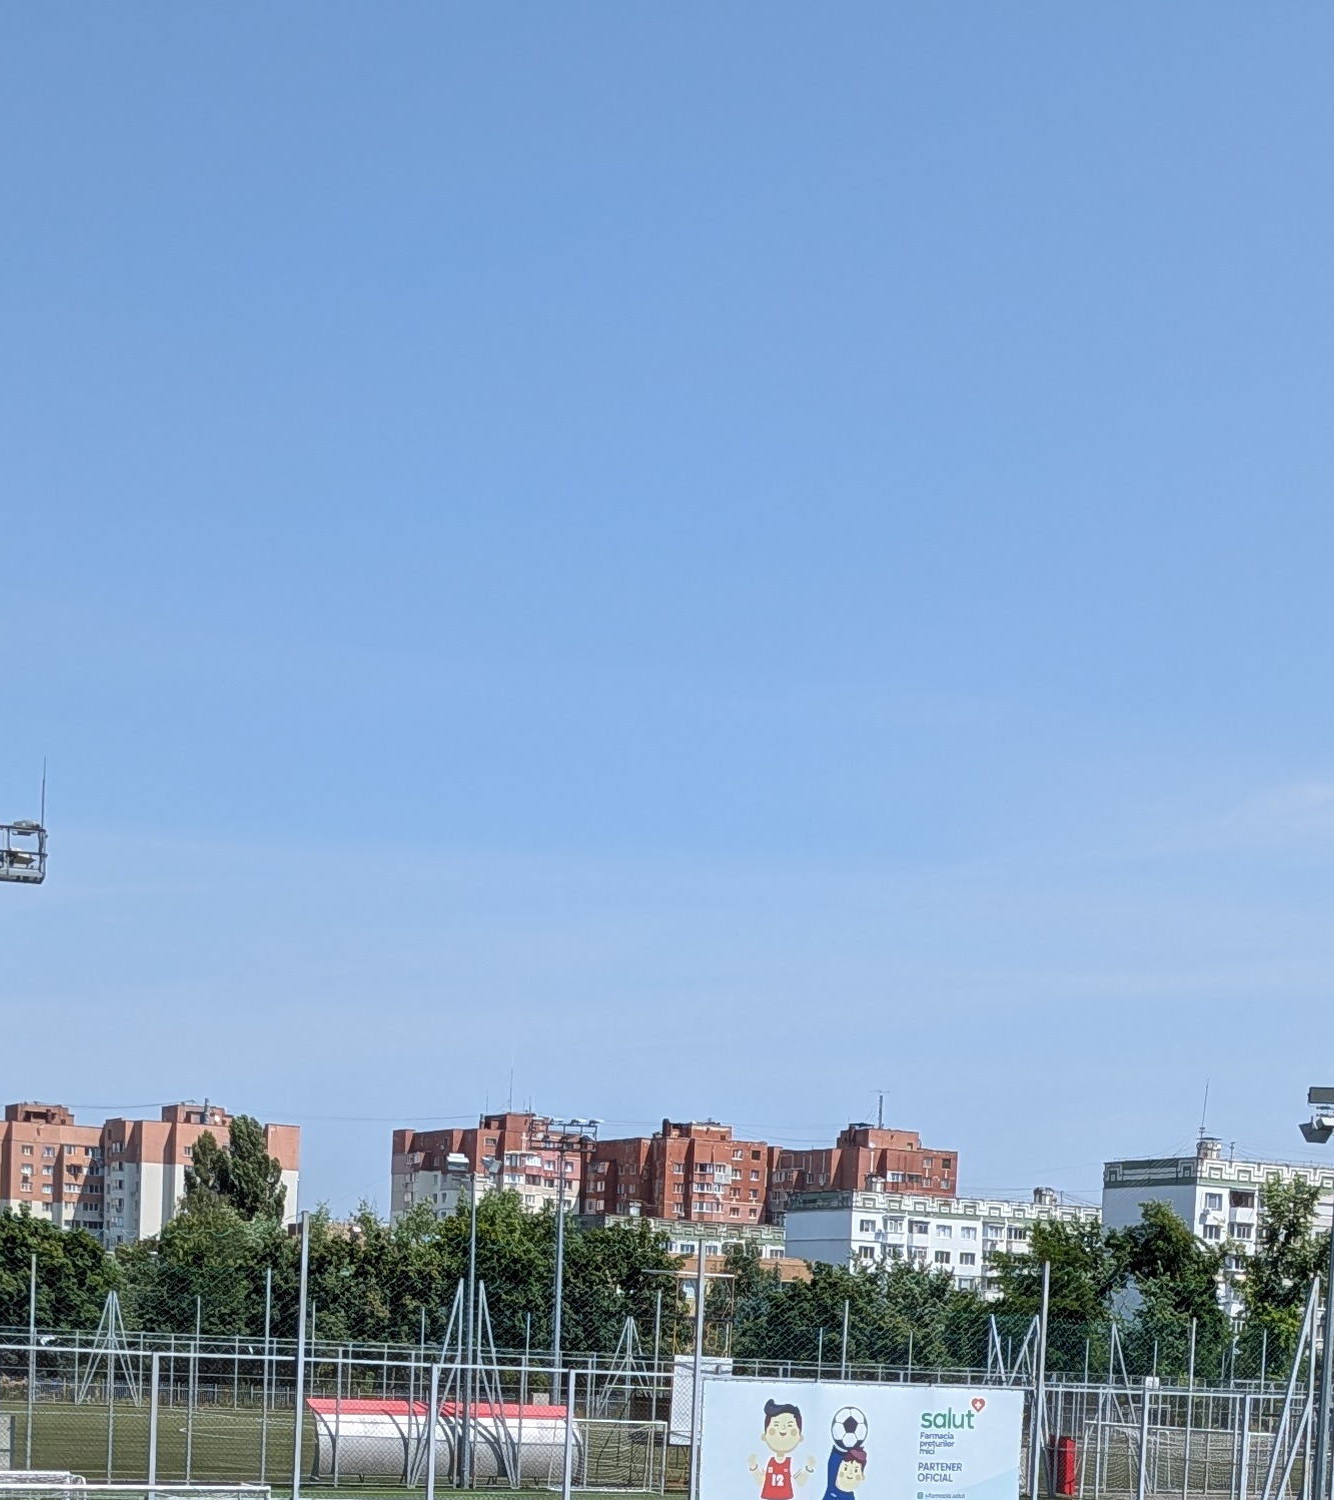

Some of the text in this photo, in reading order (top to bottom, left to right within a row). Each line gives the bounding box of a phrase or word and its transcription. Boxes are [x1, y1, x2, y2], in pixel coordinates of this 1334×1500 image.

[921, 1407, 975, 1429] salut
[920, 1432, 954, 1440] Farmacia
[918, 1462, 962, 1471] PARTENER
[771, 1474, 785, 1487] 12
[917, 1473, 953, 1482] OFICIAL
